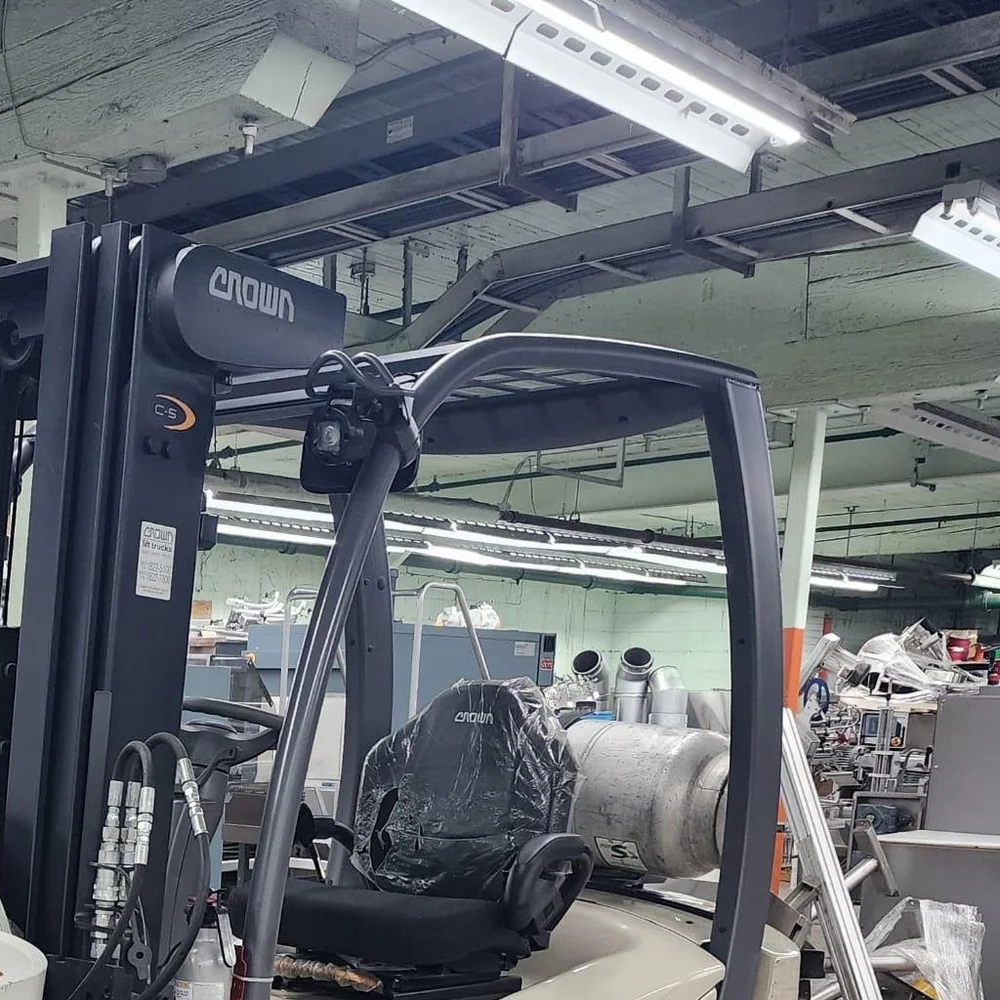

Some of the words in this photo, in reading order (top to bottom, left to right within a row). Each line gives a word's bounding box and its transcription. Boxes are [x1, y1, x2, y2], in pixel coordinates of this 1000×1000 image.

[208, 266, 295, 323] CROWN
[143, 526, 174, 543] CROWN
[454, 711, 494, 724] CROWN
